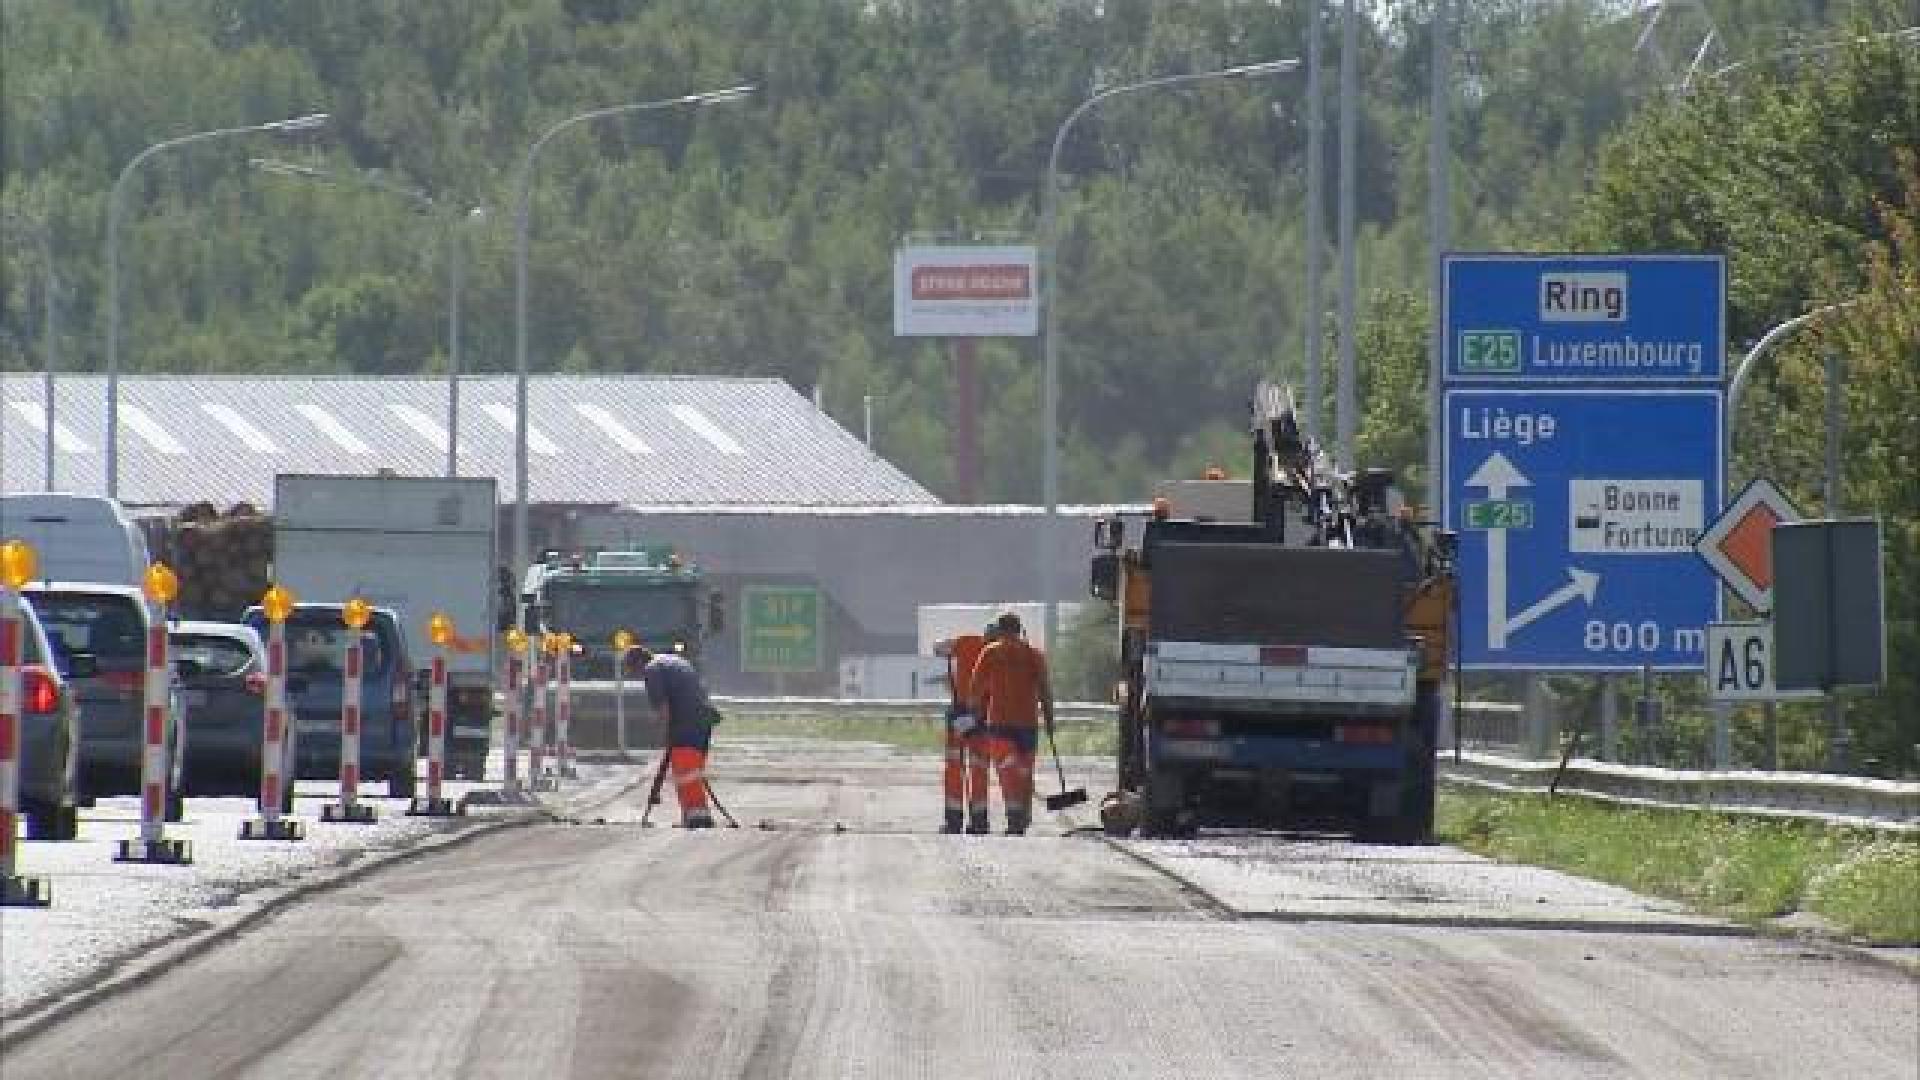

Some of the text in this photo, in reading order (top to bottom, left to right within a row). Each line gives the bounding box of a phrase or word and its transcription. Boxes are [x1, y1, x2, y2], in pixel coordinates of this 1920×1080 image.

[1544, 281, 1622, 318] Ring
[1463, 335, 1702, 372] E25 Luxembourg
[1462, 407, 1556, 444] Liège
[1604, 485, 1681, 511] Bonne
[1604, 521, 1698, 548] Fortune
[1584, 620, 1705, 652] 800 m
